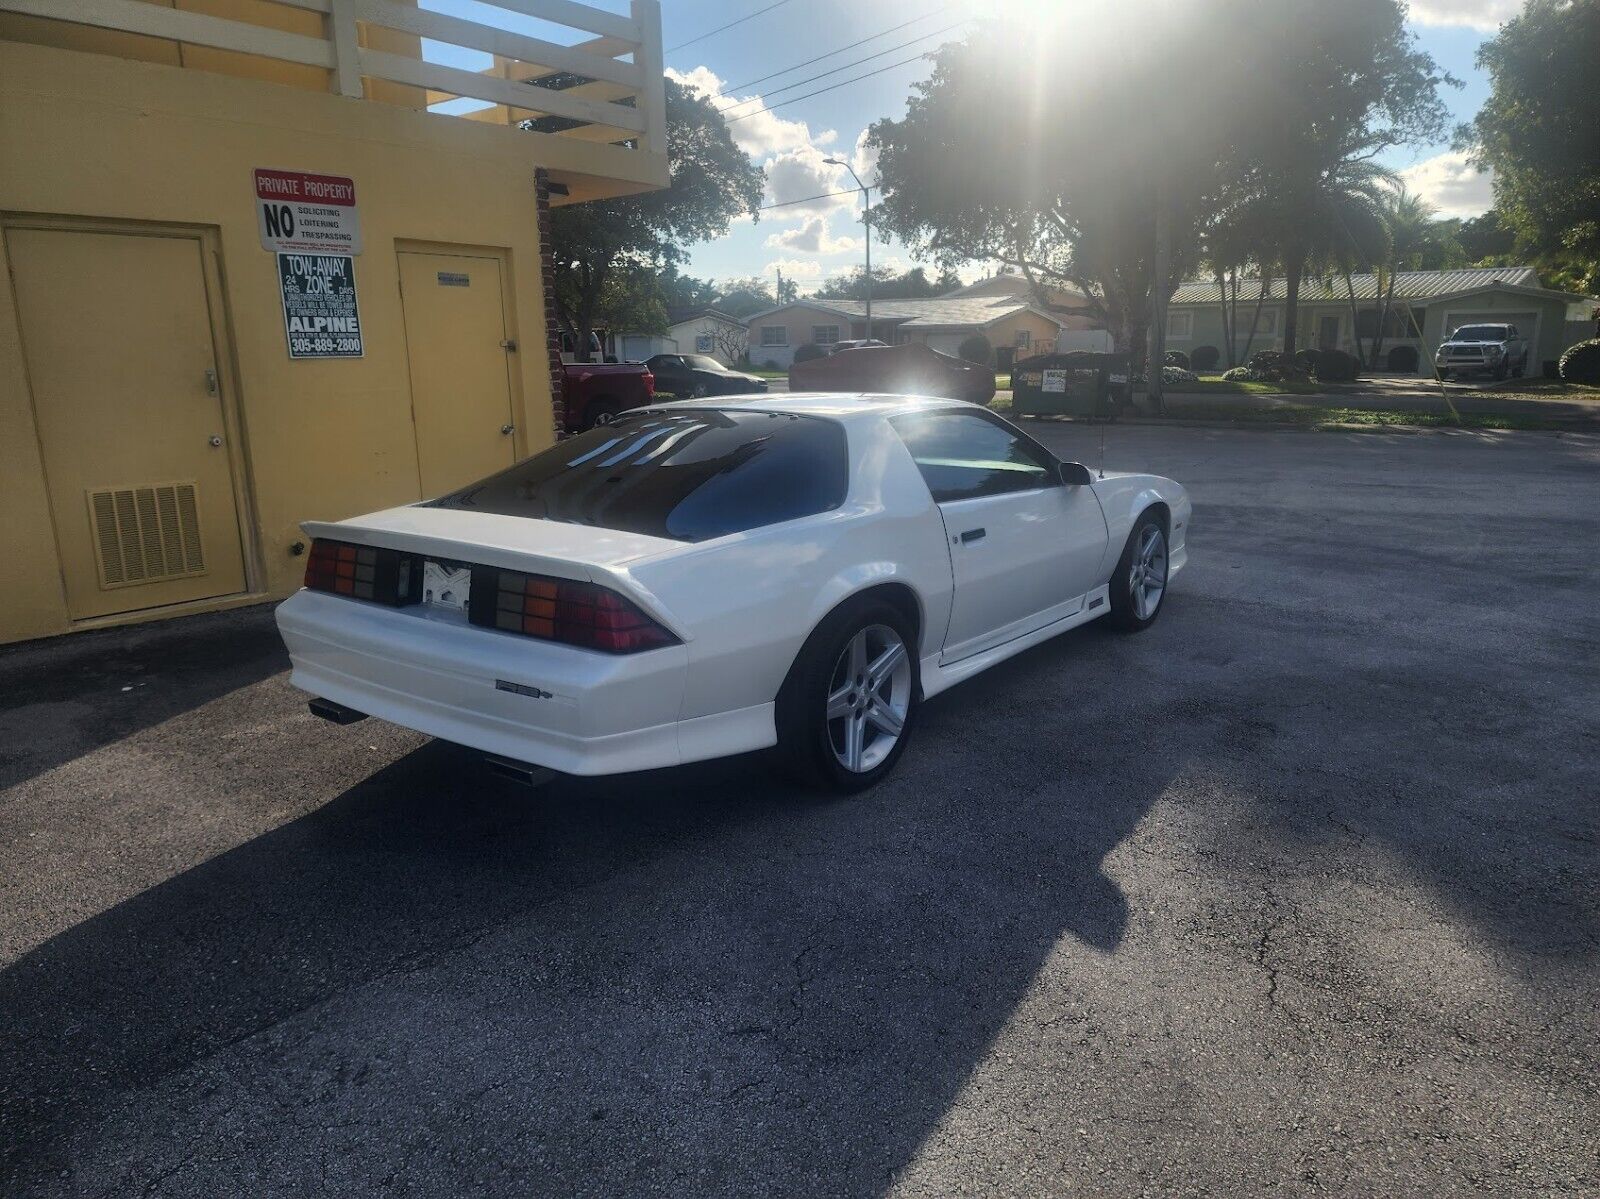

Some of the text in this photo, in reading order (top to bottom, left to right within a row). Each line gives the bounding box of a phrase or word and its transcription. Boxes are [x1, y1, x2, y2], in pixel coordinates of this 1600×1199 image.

[258, 177, 352, 199] PRIVATE PROPERTY
[298, 207, 340, 217] SOLICITING
[264, 204, 294, 238] NO
[299, 220, 339, 228] LOITERING
[301, 231, 352, 241] TRESPASSING
[287, 256, 345, 277] TOW-AWAY
[286, 275, 296, 284] 24
[305, 276, 334, 294] ZONE
[343, 277, 347, 286] 7
[285, 285, 300, 293] HRS
[290, 317, 359, 332] ALPINE
[292, 339, 360, 352] 305-889-2800
